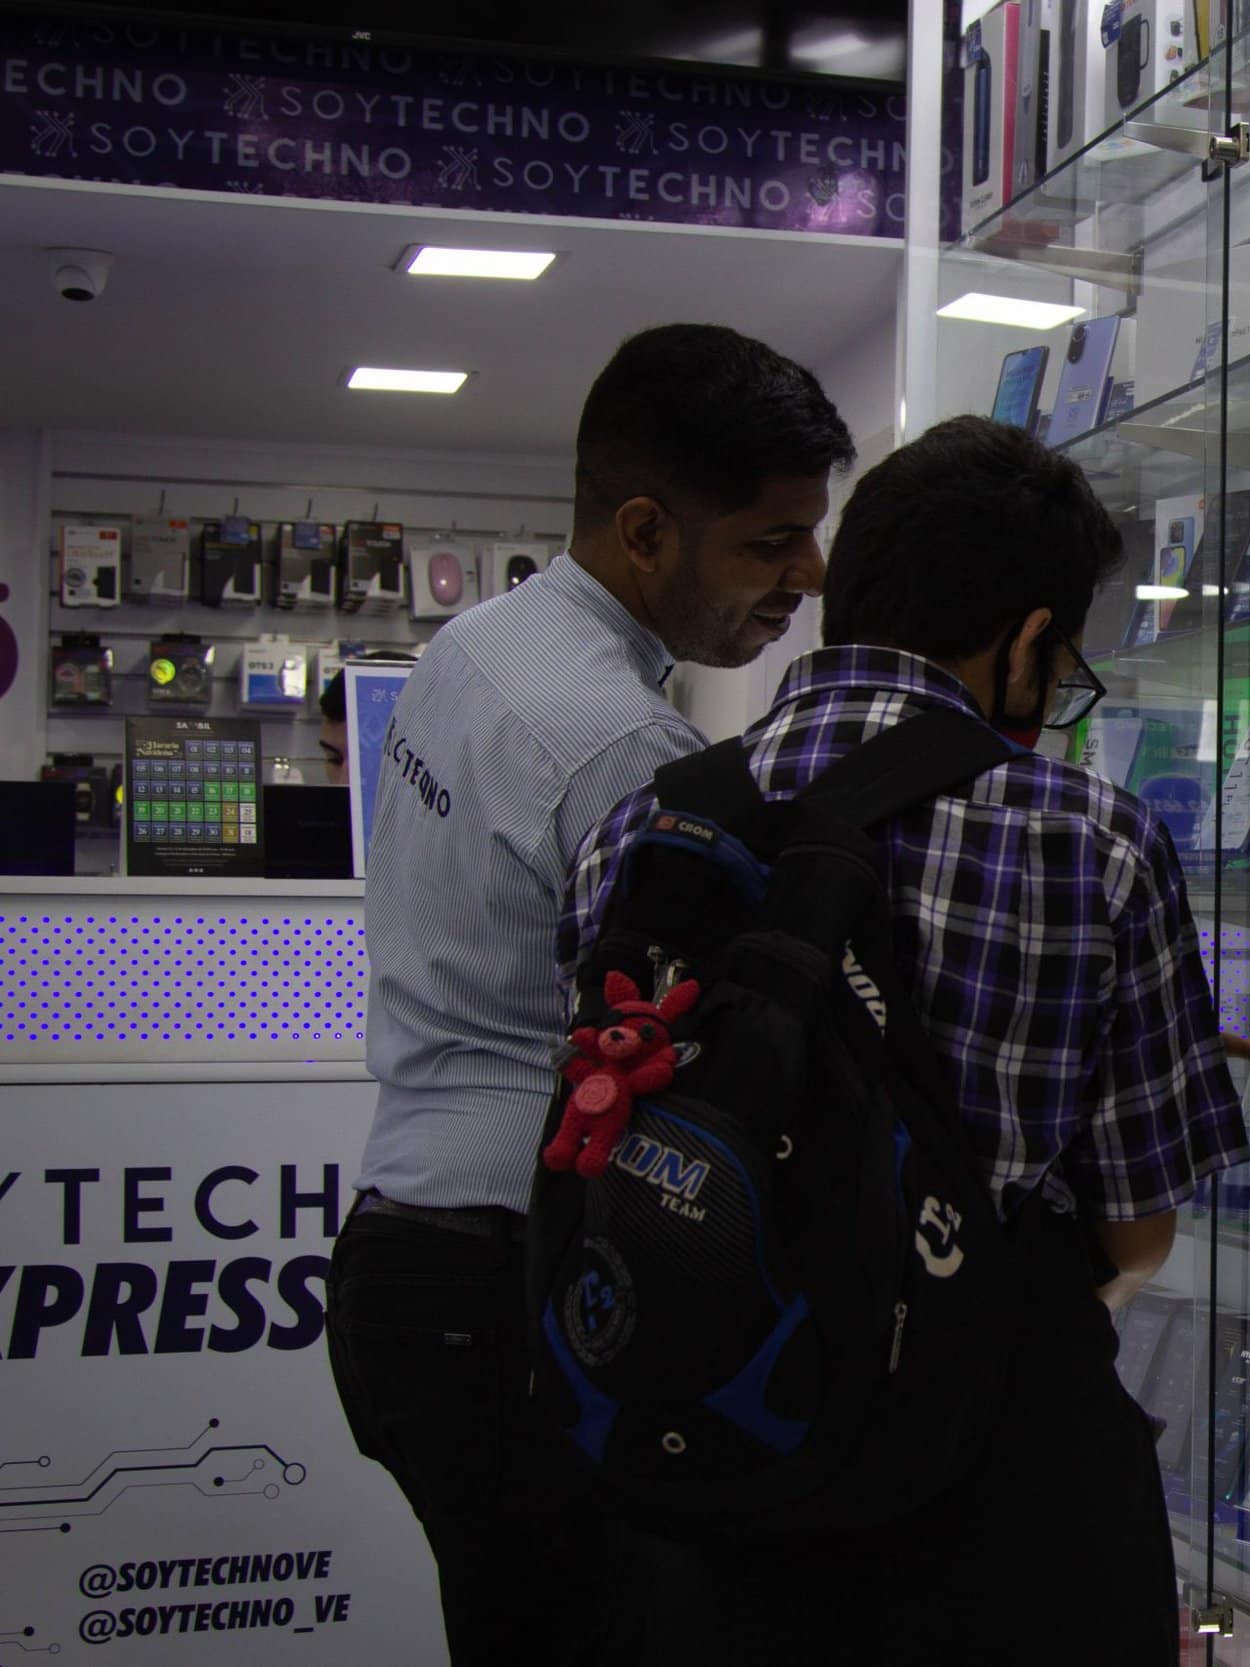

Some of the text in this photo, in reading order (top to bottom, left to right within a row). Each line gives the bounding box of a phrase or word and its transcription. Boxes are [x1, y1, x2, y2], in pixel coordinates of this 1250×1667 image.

[352, 31, 372, 40] JVC
[4, 58, 188, 106] ECHNO
[281, 85, 590, 142] SOYTECHNO
[90, 122, 411, 180] SOYTECHNO
[668, 122, 908, 173] SOYTECHN
[492, 157, 790, 212] SOYTECHNO
[660, 1191, 707, 1223] TEAM
[0, 1255, 334, 1360] PRESS
[79, 1551, 333, 1599] @SOYTECHNOVE
[79, 1594, 351, 1645] @SOYTECHNO_VE
